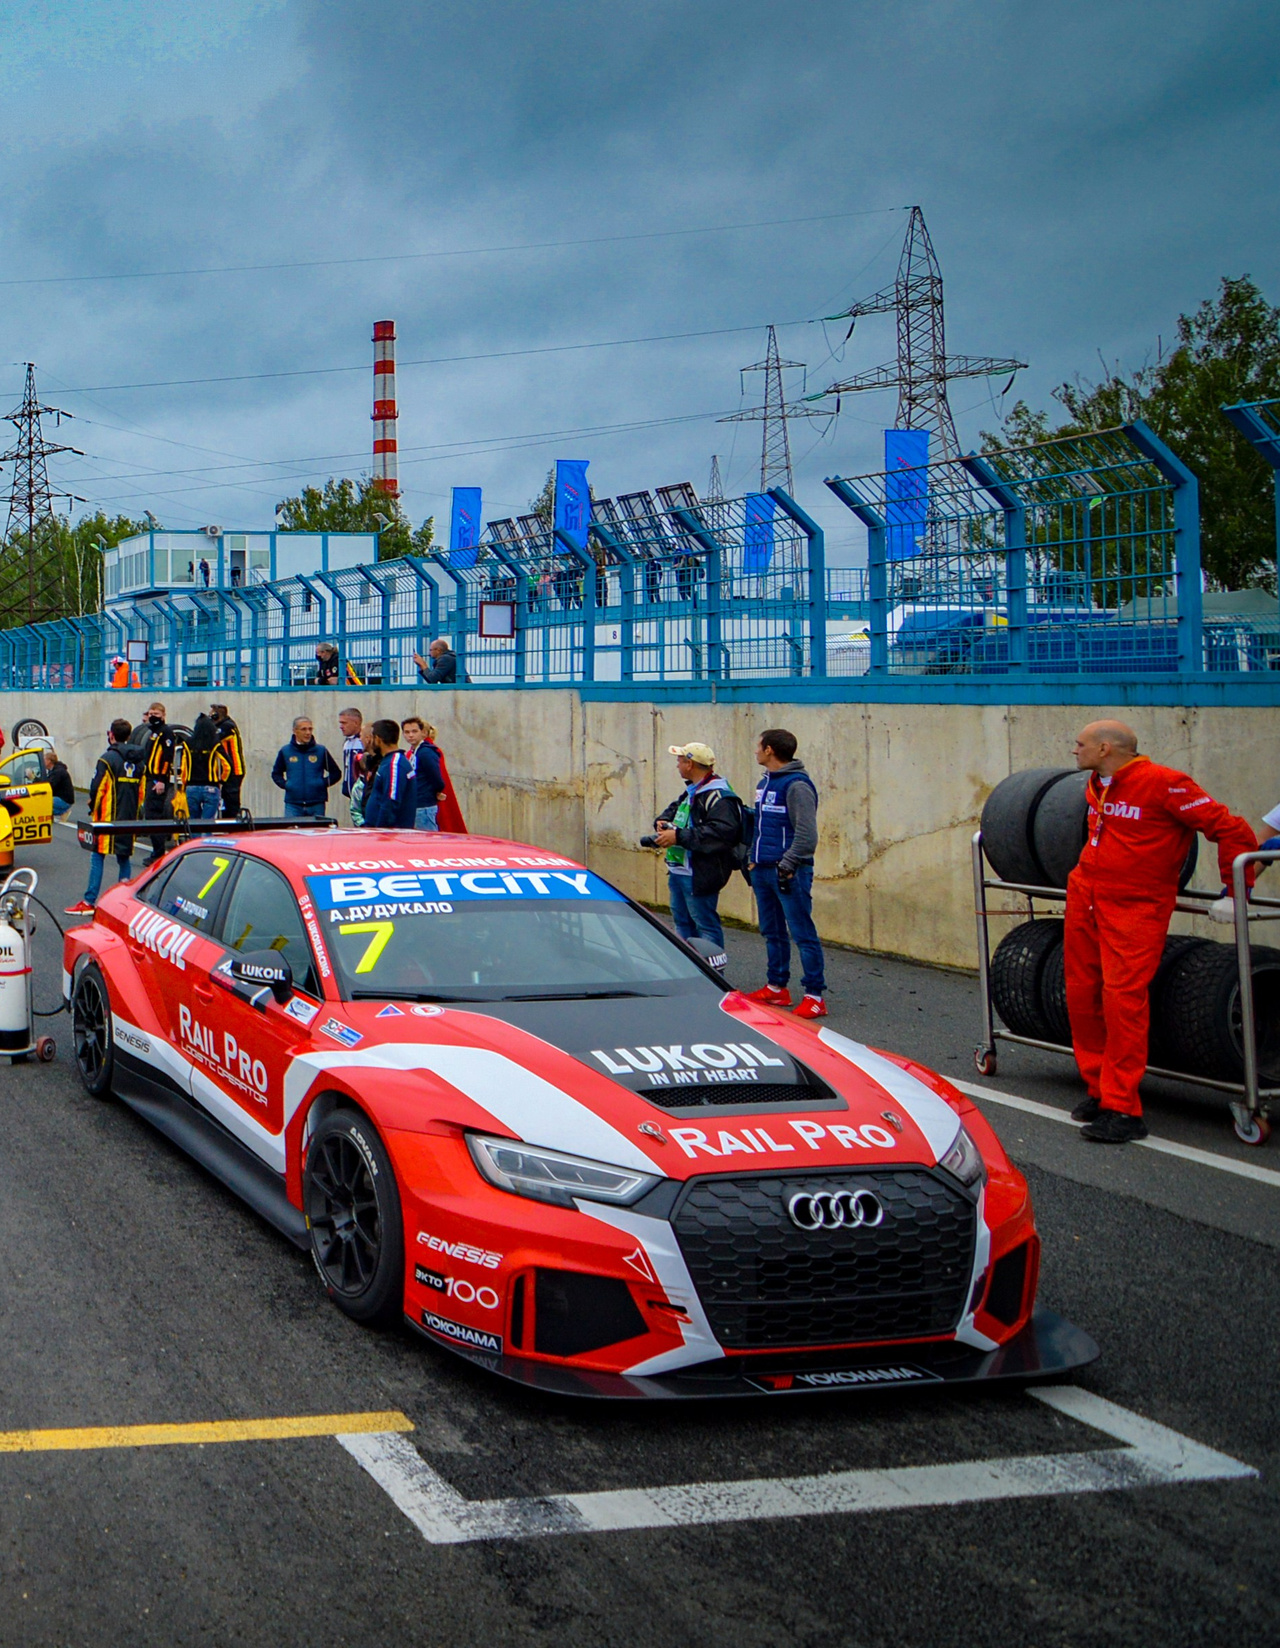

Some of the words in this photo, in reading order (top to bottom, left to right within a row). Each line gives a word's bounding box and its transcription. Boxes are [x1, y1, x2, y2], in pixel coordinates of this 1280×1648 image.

[5, 787, 27, 796] АВТО
[14, 816, 35, 825] LADA
[198, 857, 229, 900] 7
[307, 859, 405, 873] LUKOIL
[408, 856, 507, 868] RACING
[507, 856, 576, 868] TEAM
[330, 872, 592, 902] BETCITY
[329, 902, 454, 923] А.ДУДУКАЛО
[129, 906, 197, 971] LUKOIL
[339, 921, 395, 974] 7
[241, 963, 287, 981] LUKOIL
[115, 1027, 151, 1053] GENESIS
[179, 1002, 220, 1063] RAIL
[224, 1031, 269, 1094] PRO
[590, 1043, 784, 1075] LUKOIL
[217, 1064, 269, 1107] OPERATOR
[648, 1072, 670, 1085] IN
[674, 1071, 701, 1084] MY
[706, 1069, 759, 1082] HEART
[349, 1126, 379, 1176] ADVAN
[668, 1128, 795, 1158] RAIL
[788, 1120, 896, 1150] PRO
[416, 1230, 501, 1270] GENESIS
[415, 1268, 443, 1288] ЭКТО
[444, 1276, 500, 1309] 100
[424, 1312, 499, 1350] YOKOHAMA
[796, 1366, 922, 1386] YOKOHAMA
